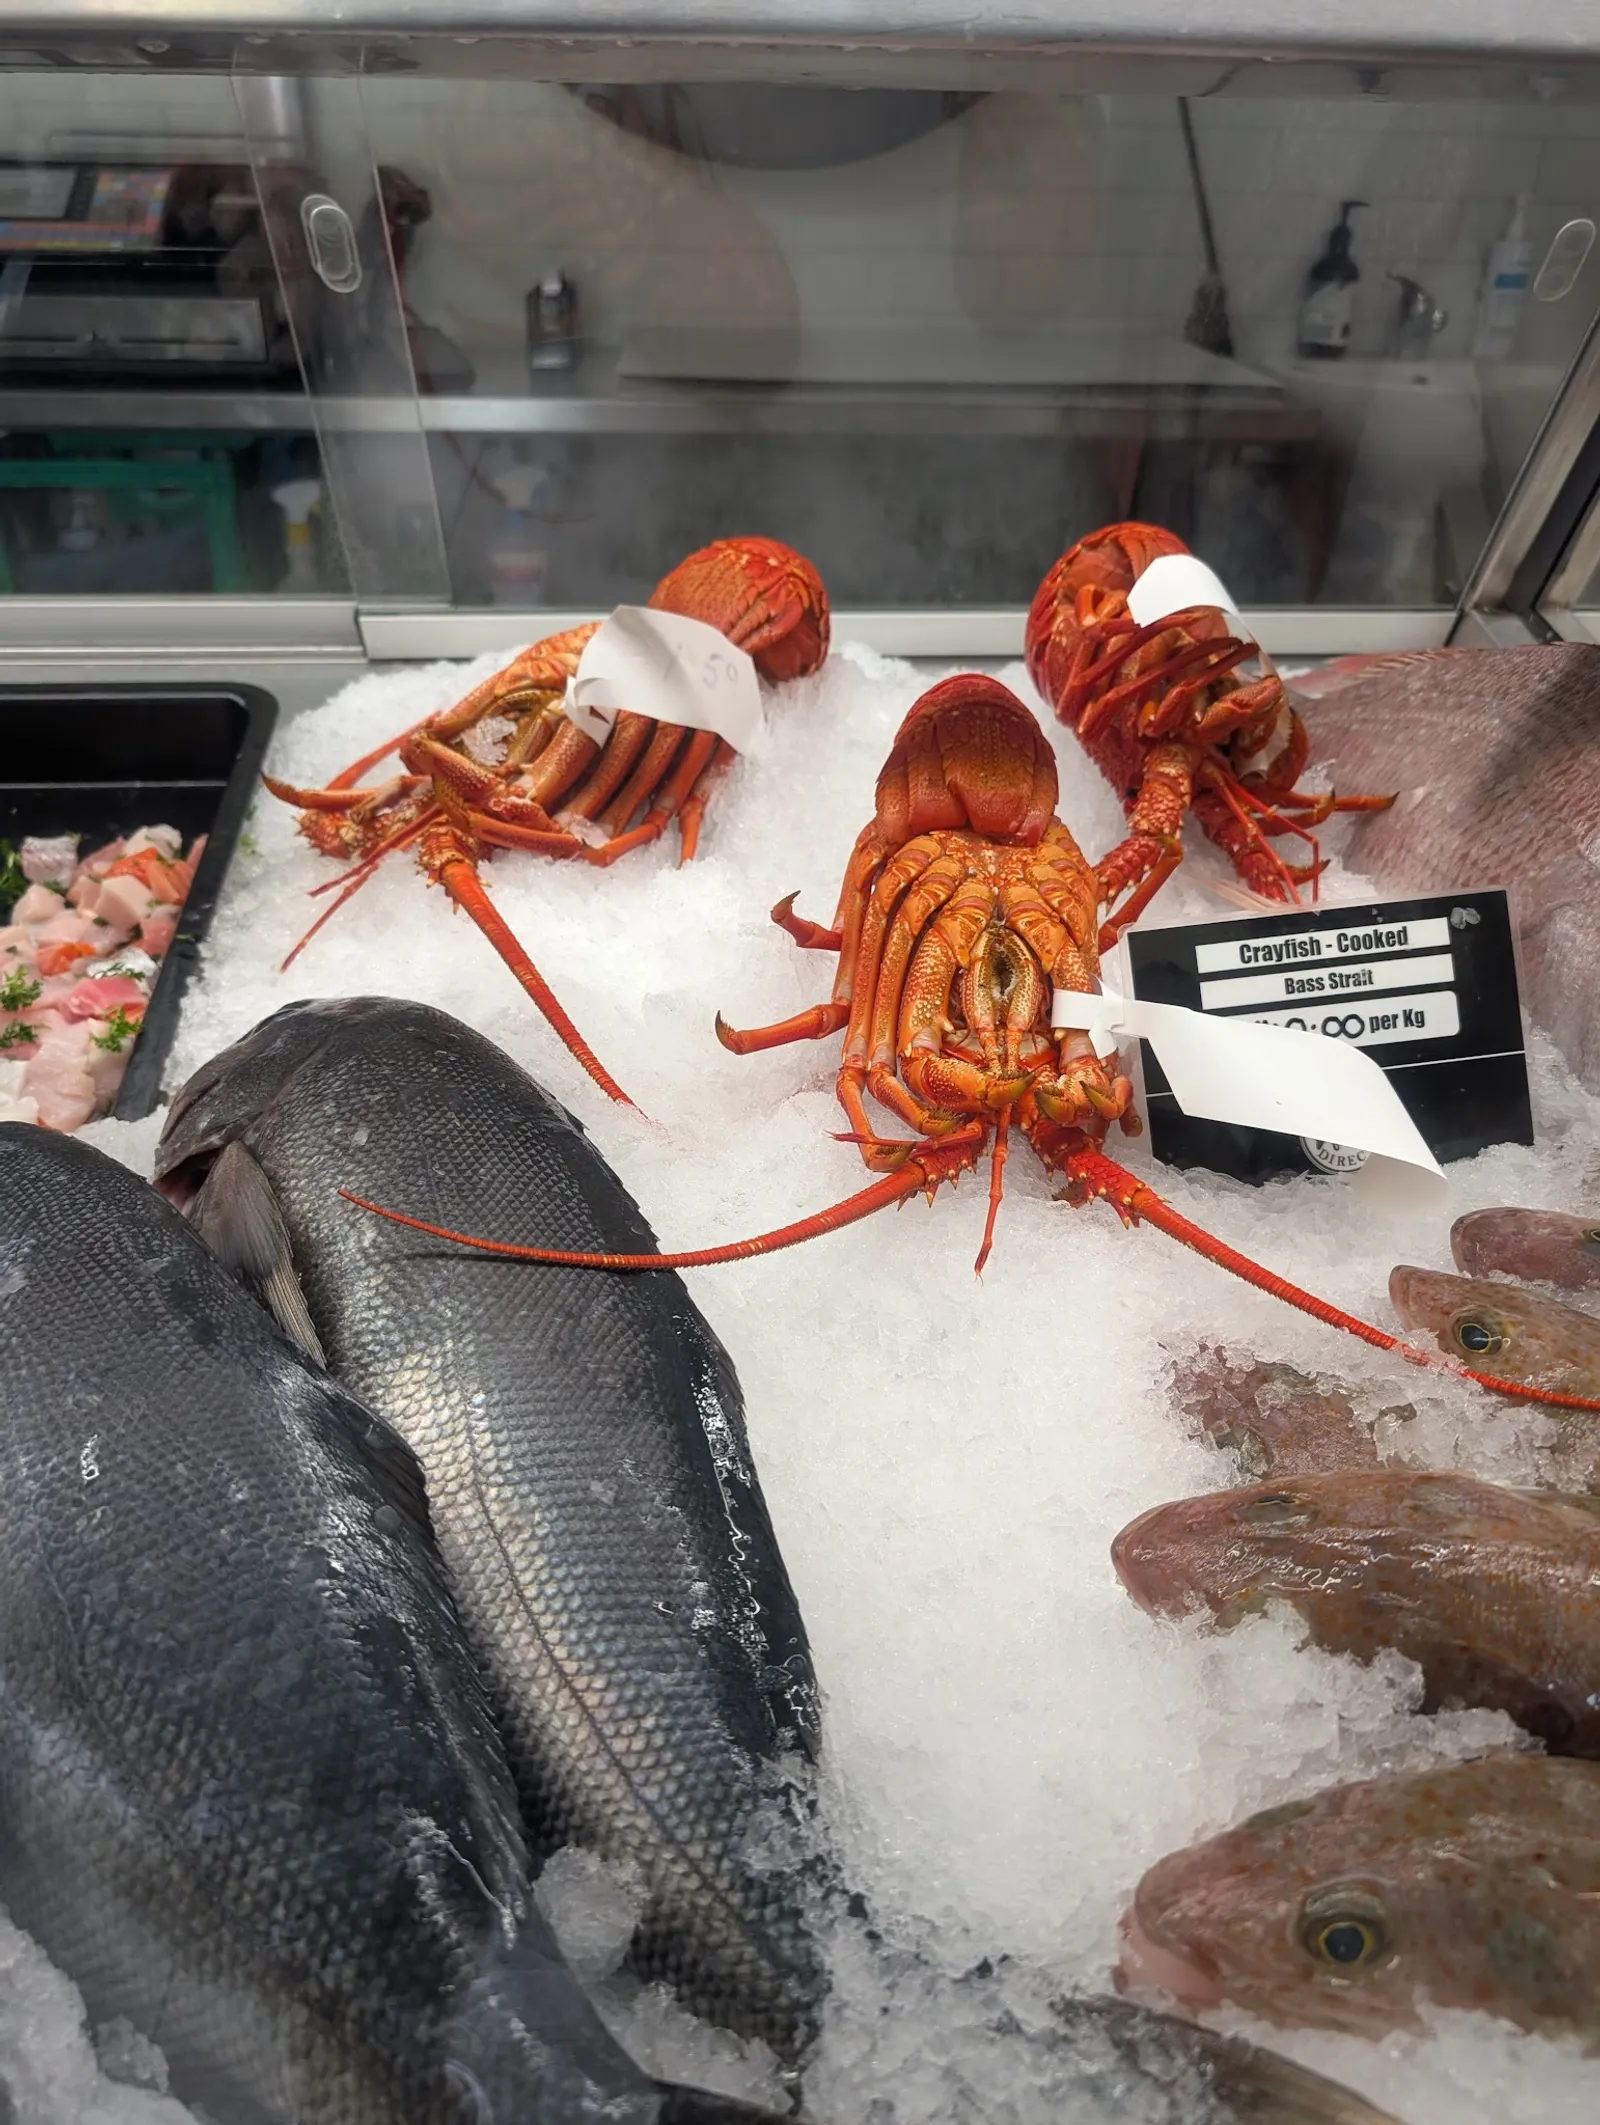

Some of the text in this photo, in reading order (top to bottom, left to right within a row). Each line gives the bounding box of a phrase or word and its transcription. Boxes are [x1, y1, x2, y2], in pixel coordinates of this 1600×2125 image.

[1239, 935, 1322, 964] Crayfish
[1336, 925, 1409, 953] Cooked
[1284, 968, 1374, 995] Bass Strait
[1369, 1013, 1399, 1033] per
[1402, 1008, 1425, 1028] Kg
[1318, 1149, 1367, 1167] DIREC
